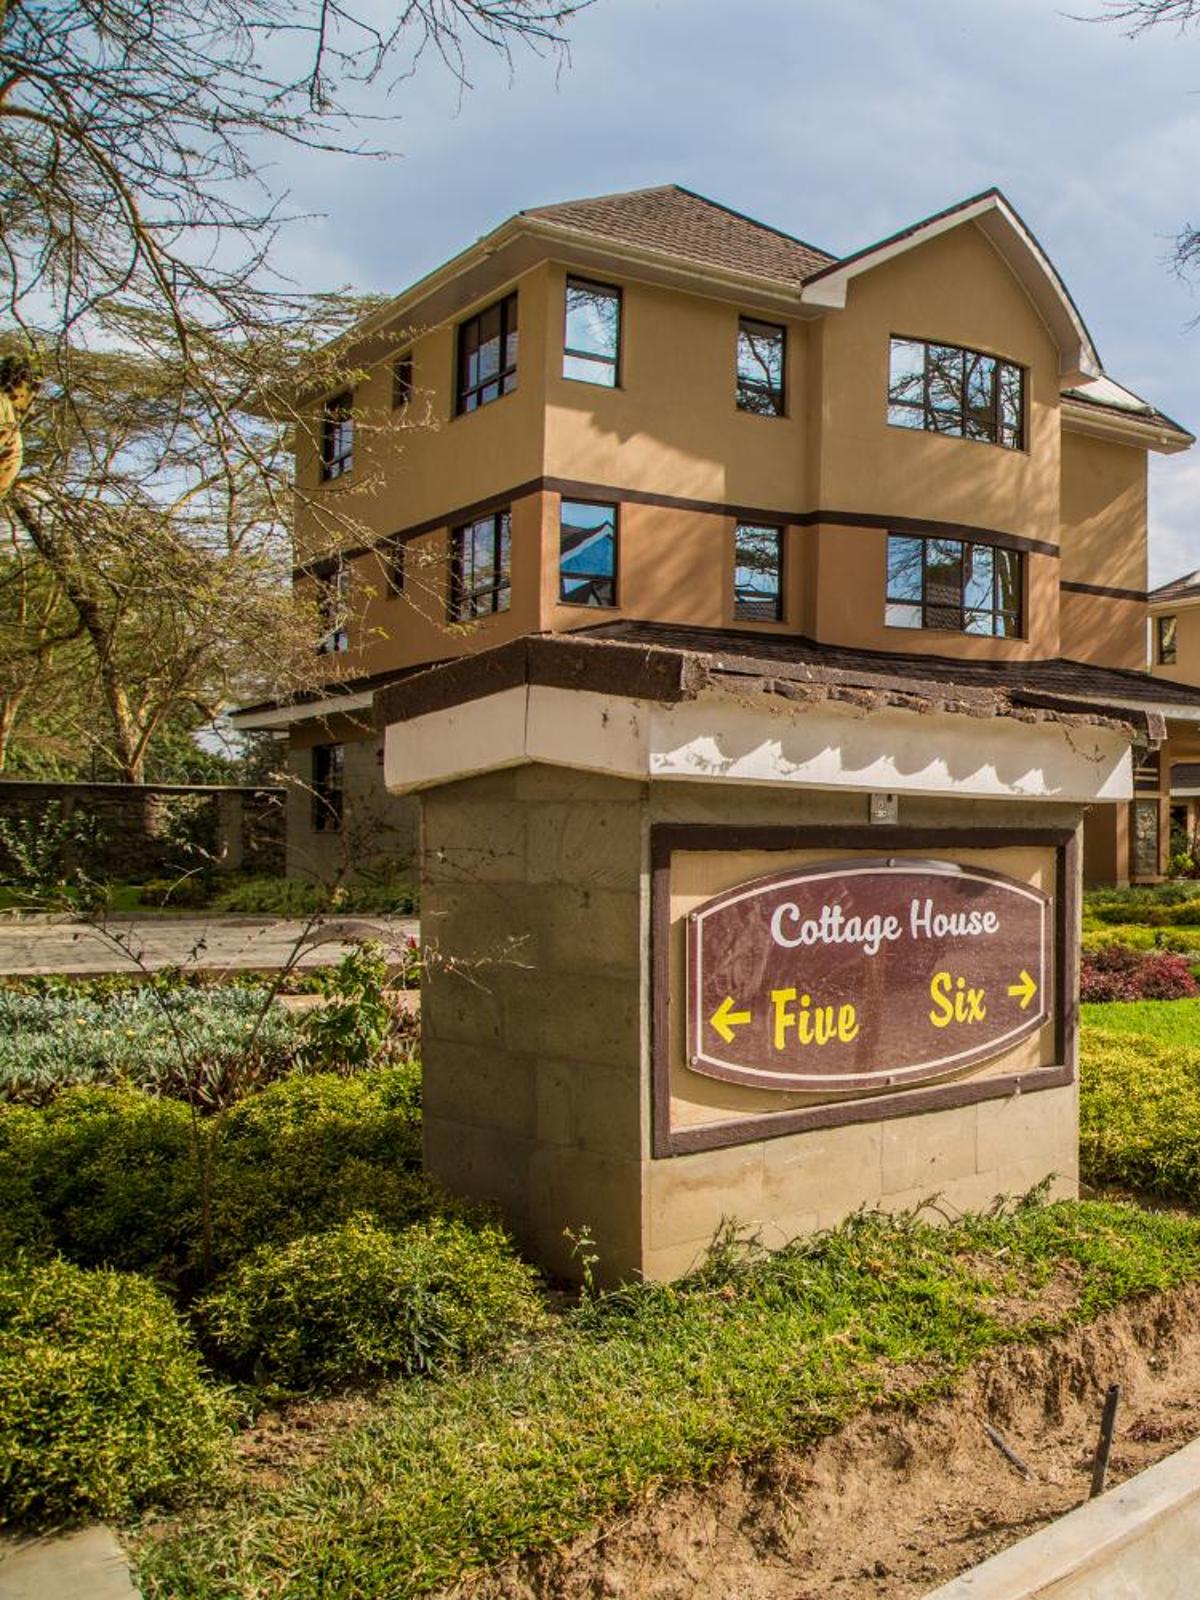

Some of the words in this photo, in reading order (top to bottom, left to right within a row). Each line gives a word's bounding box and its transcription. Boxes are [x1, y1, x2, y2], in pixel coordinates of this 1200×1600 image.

[771, 902, 902, 955] Cottage
[910, 899, 1000, 939] House
[771, 987, 860, 1050] Five
[929, 972, 987, 1028] Six
